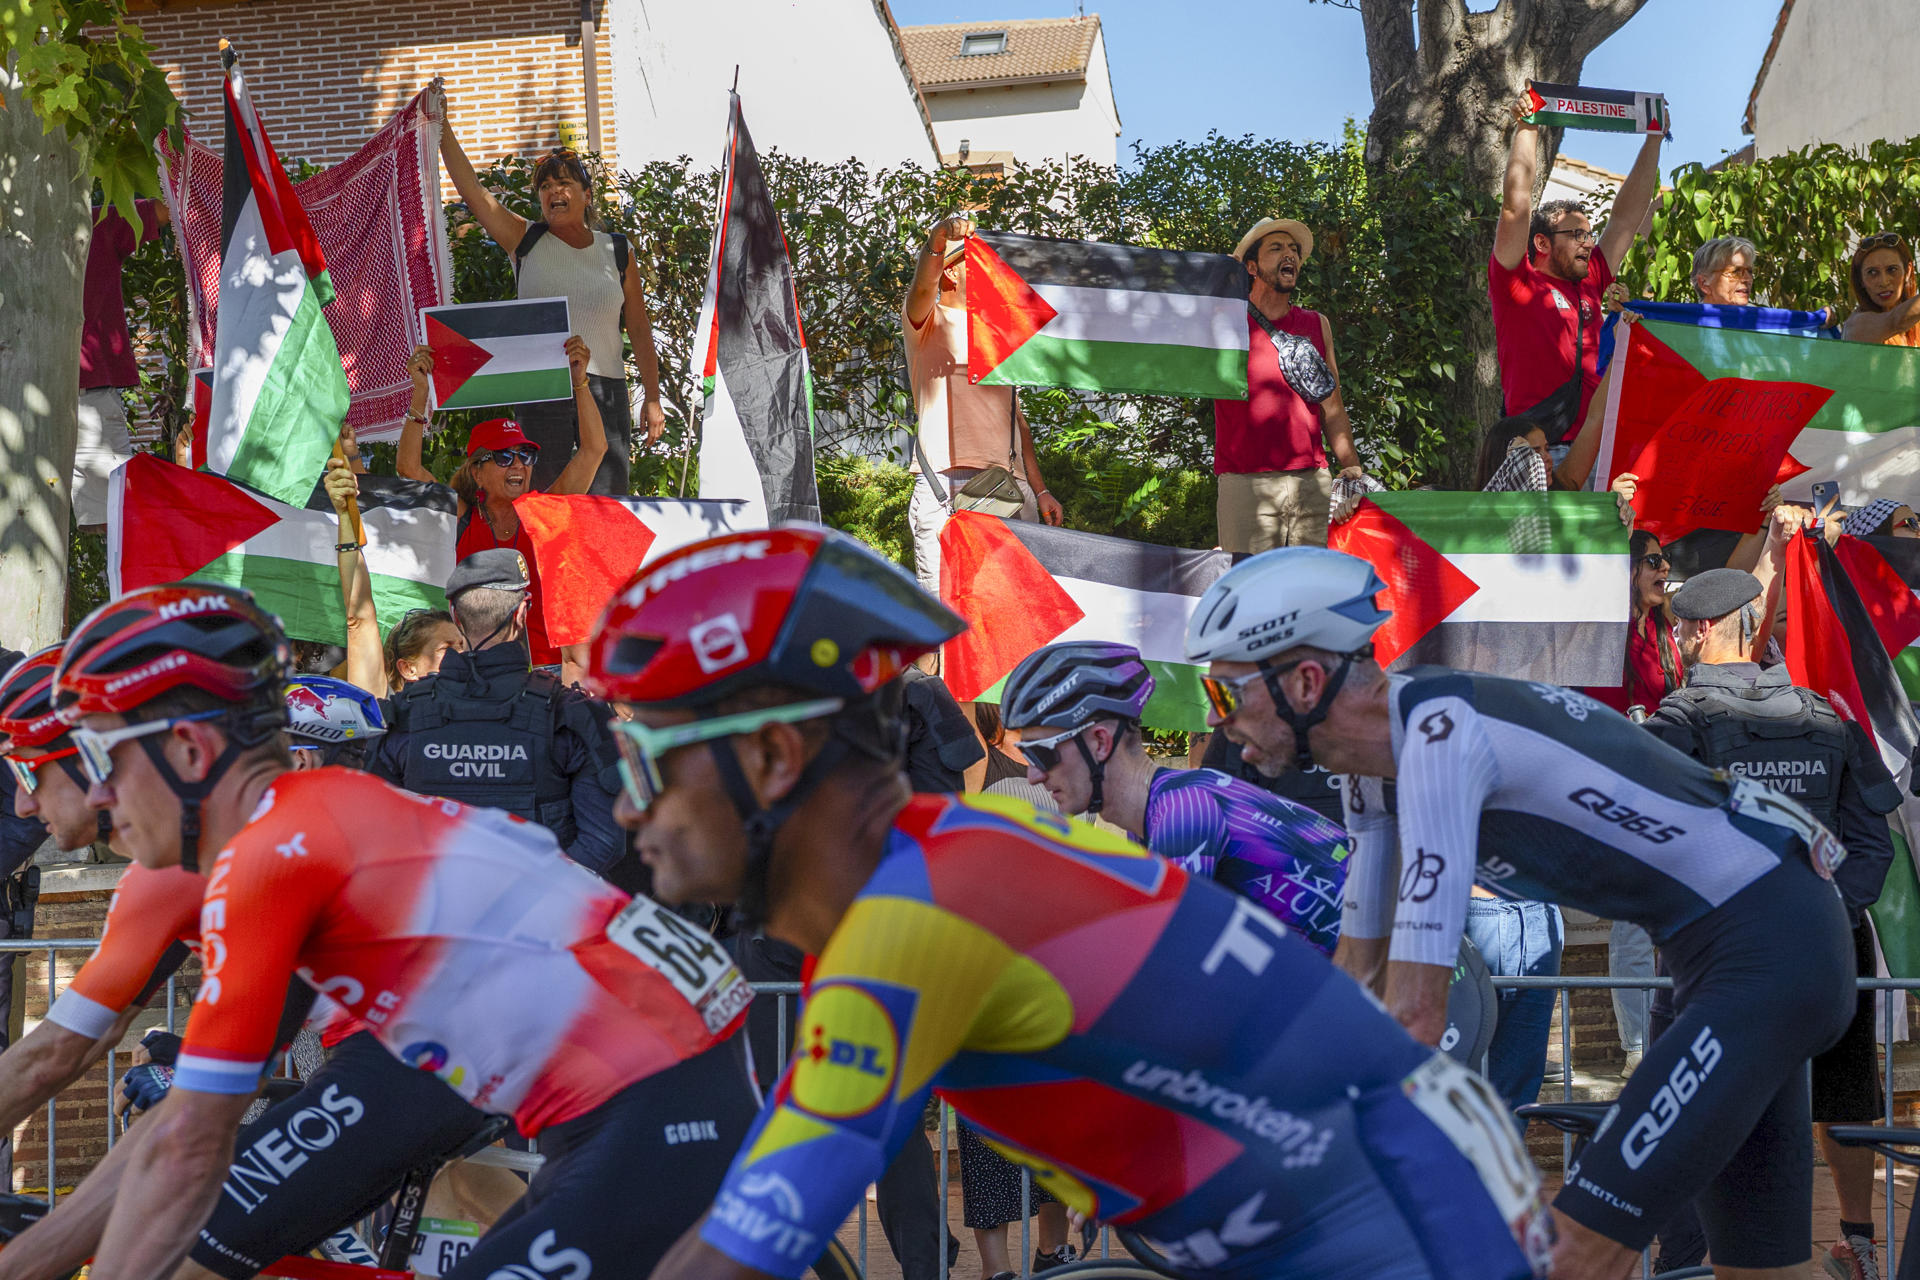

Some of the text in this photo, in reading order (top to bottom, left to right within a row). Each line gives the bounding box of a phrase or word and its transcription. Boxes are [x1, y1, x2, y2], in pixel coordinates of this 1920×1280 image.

[1557, 99, 1626, 117] PALESTINE
[1237, 608, 1301, 641] SCOTT
[1036, 672, 1080, 714] GIANT
[291, 720, 343, 740] ALIZED
[423, 743, 529, 761] GUARDIA
[449, 761, 506, 778] CIVIL
[1729, 760, 1828, 777] GUARDIA
[1250, 810, 1283, 828] MAAP
[196, 847, 236, 1006] INEOS
[632, 908, 725, 990] 64
[664, 1119, 719, 1145] GOBIK
[222, 1082, 365, 1215] INEOS
[394, 1185, 421, 1237] INEOS
[1577, 1177, 1643, 1218] BREITLING
